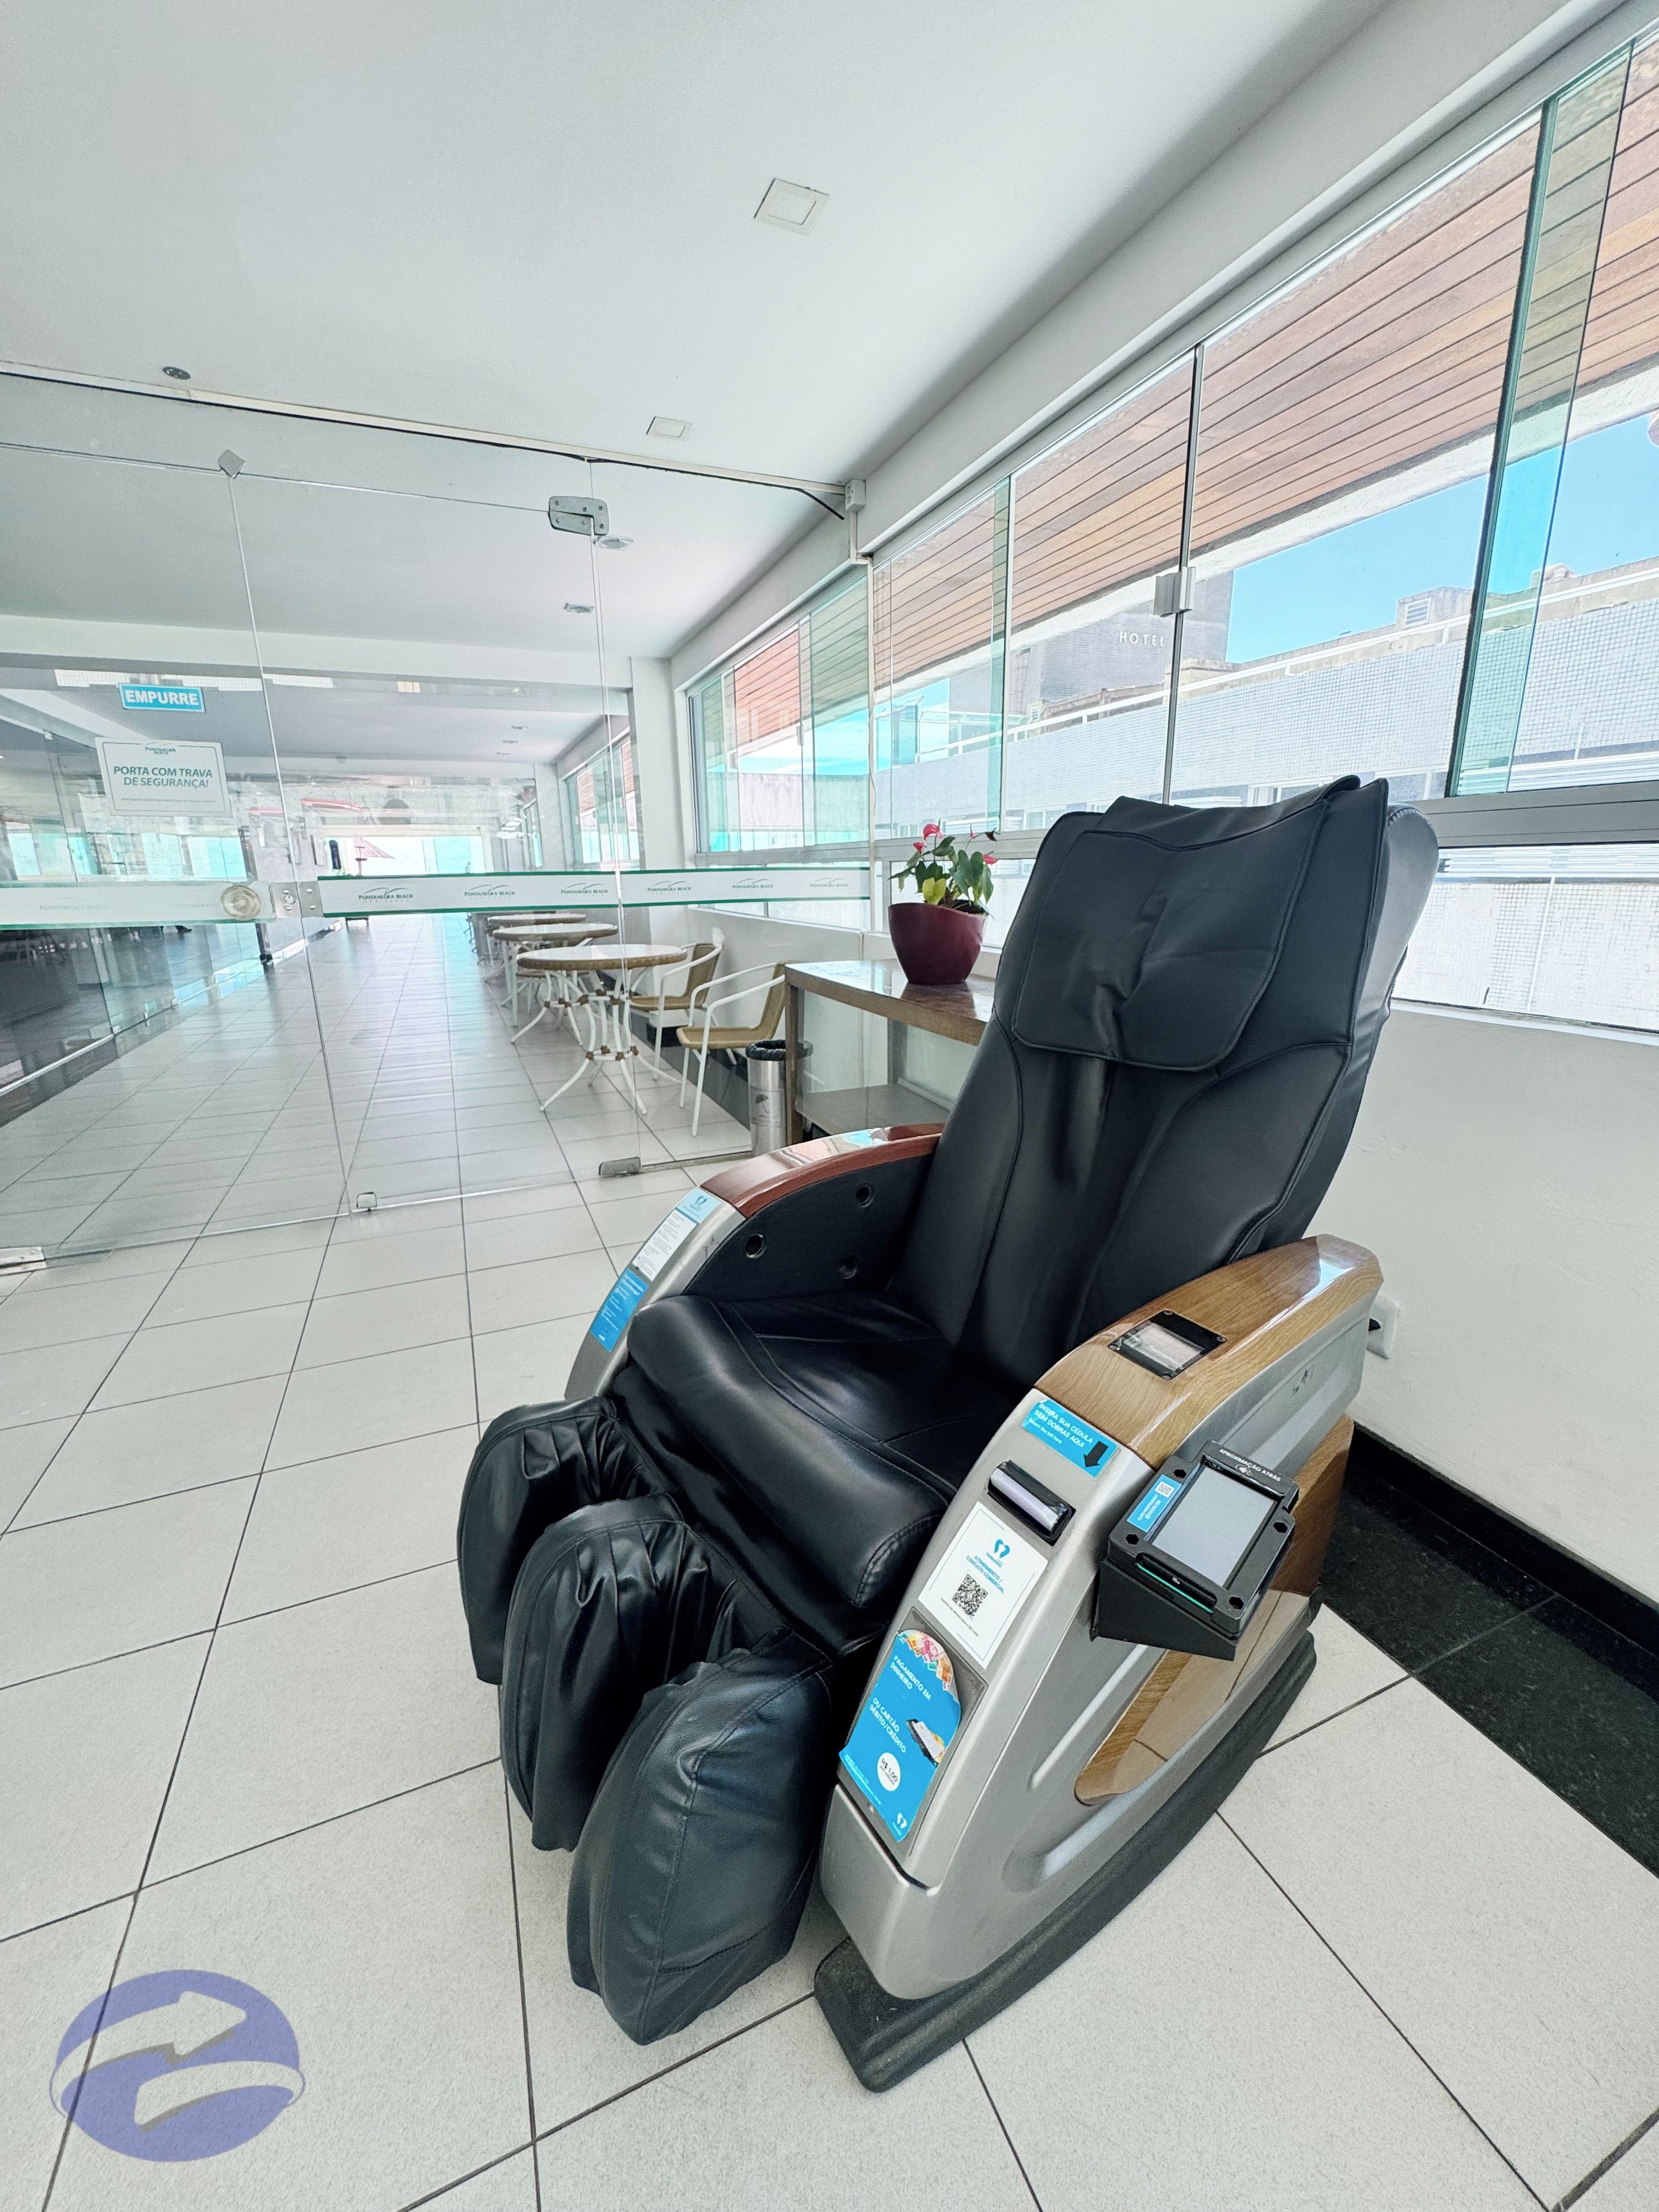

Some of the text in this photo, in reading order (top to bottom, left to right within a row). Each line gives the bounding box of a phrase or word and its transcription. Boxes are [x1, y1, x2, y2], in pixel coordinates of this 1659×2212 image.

[1119, 631, 1164, 647] HOTEL
[125, 690, 199, 706] EMPURRE
[114, 766, 213, 778] PORTA COM TRAVA
[124, 777, 209, 790] DE SEGURANÇA!
[1034, 1410, 1085, 1448] SEM DOBRAS AQUI
[1039, 1403, 1093, 1444] INSIRA SUA CÉDULA
[1219, 1449, 1281, 1482] APROXIMAÇÃO ATRÁS
[966, 1555, 984, 1573] CONTATO
[890, 1662, 912, 1690] DINHEIRO
[894, 1655, 931, 1700] PAGAMENTO EM
[873, 1698, 900, 1732] OU CARTÃO
